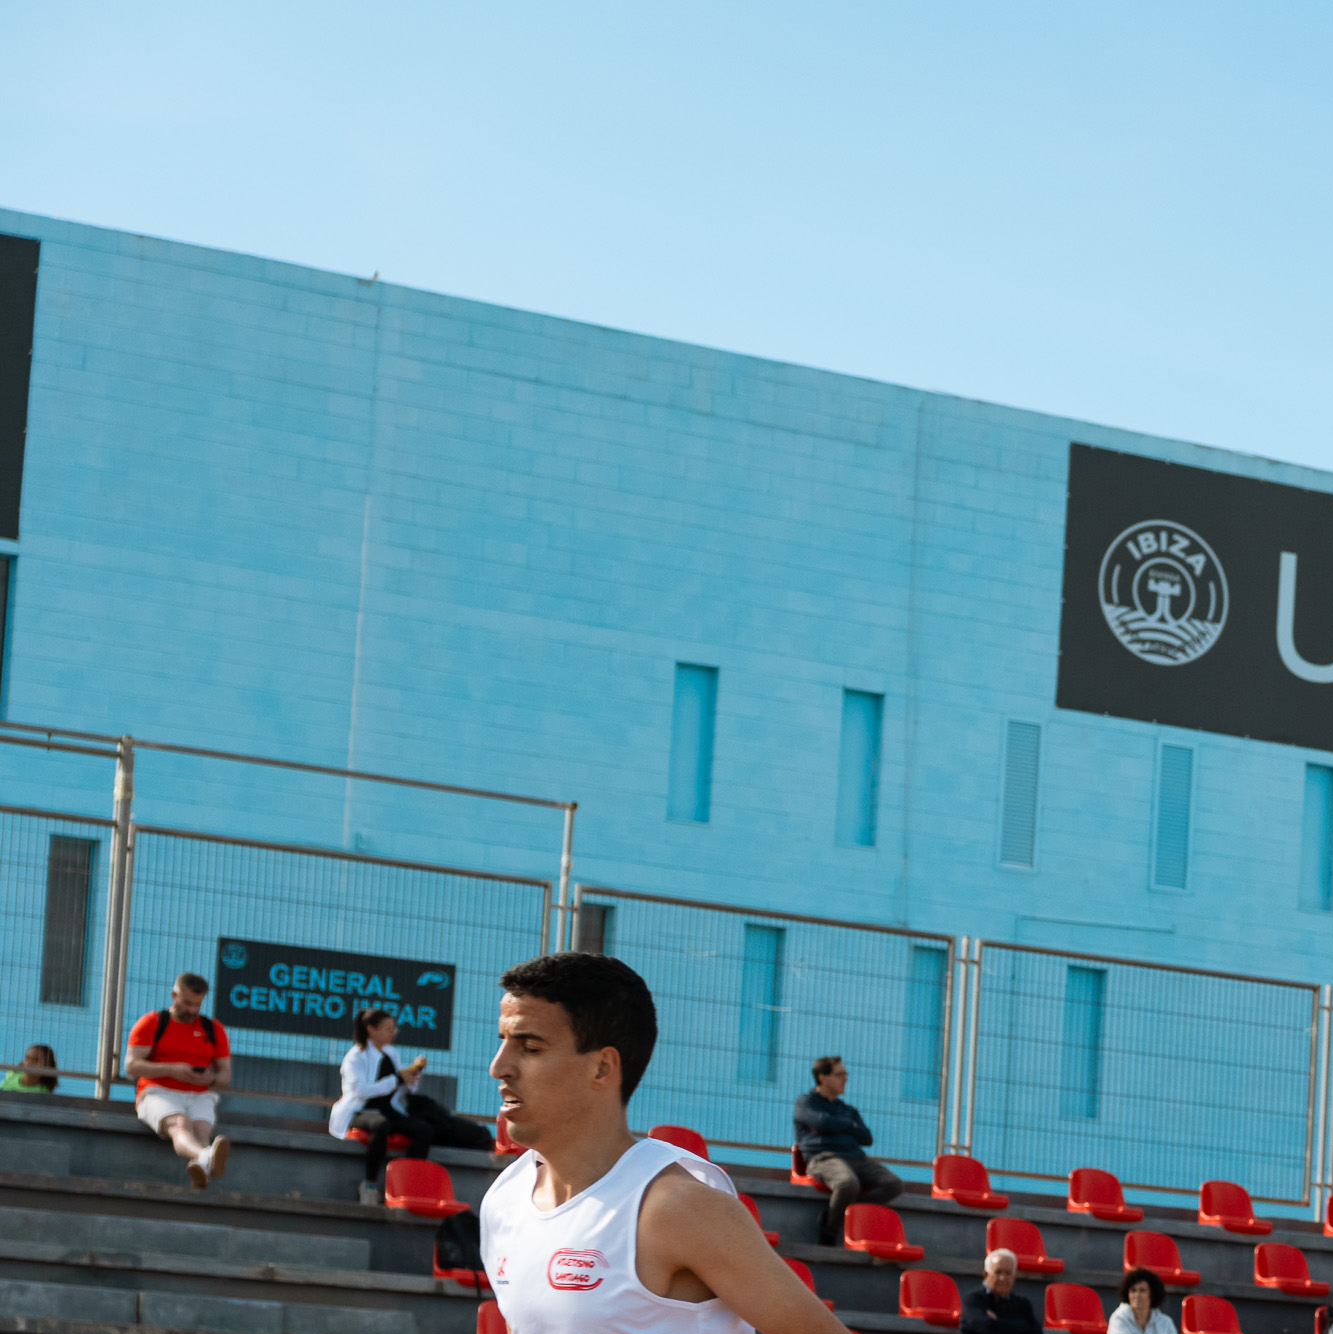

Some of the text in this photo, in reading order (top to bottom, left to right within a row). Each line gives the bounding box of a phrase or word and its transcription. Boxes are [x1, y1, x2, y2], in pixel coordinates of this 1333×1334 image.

[1126, 530, 1207, 577] IBIZA
[269, 963, 402, 1000] GENERAL
[229, 984, 347, 1020] CENTRO
